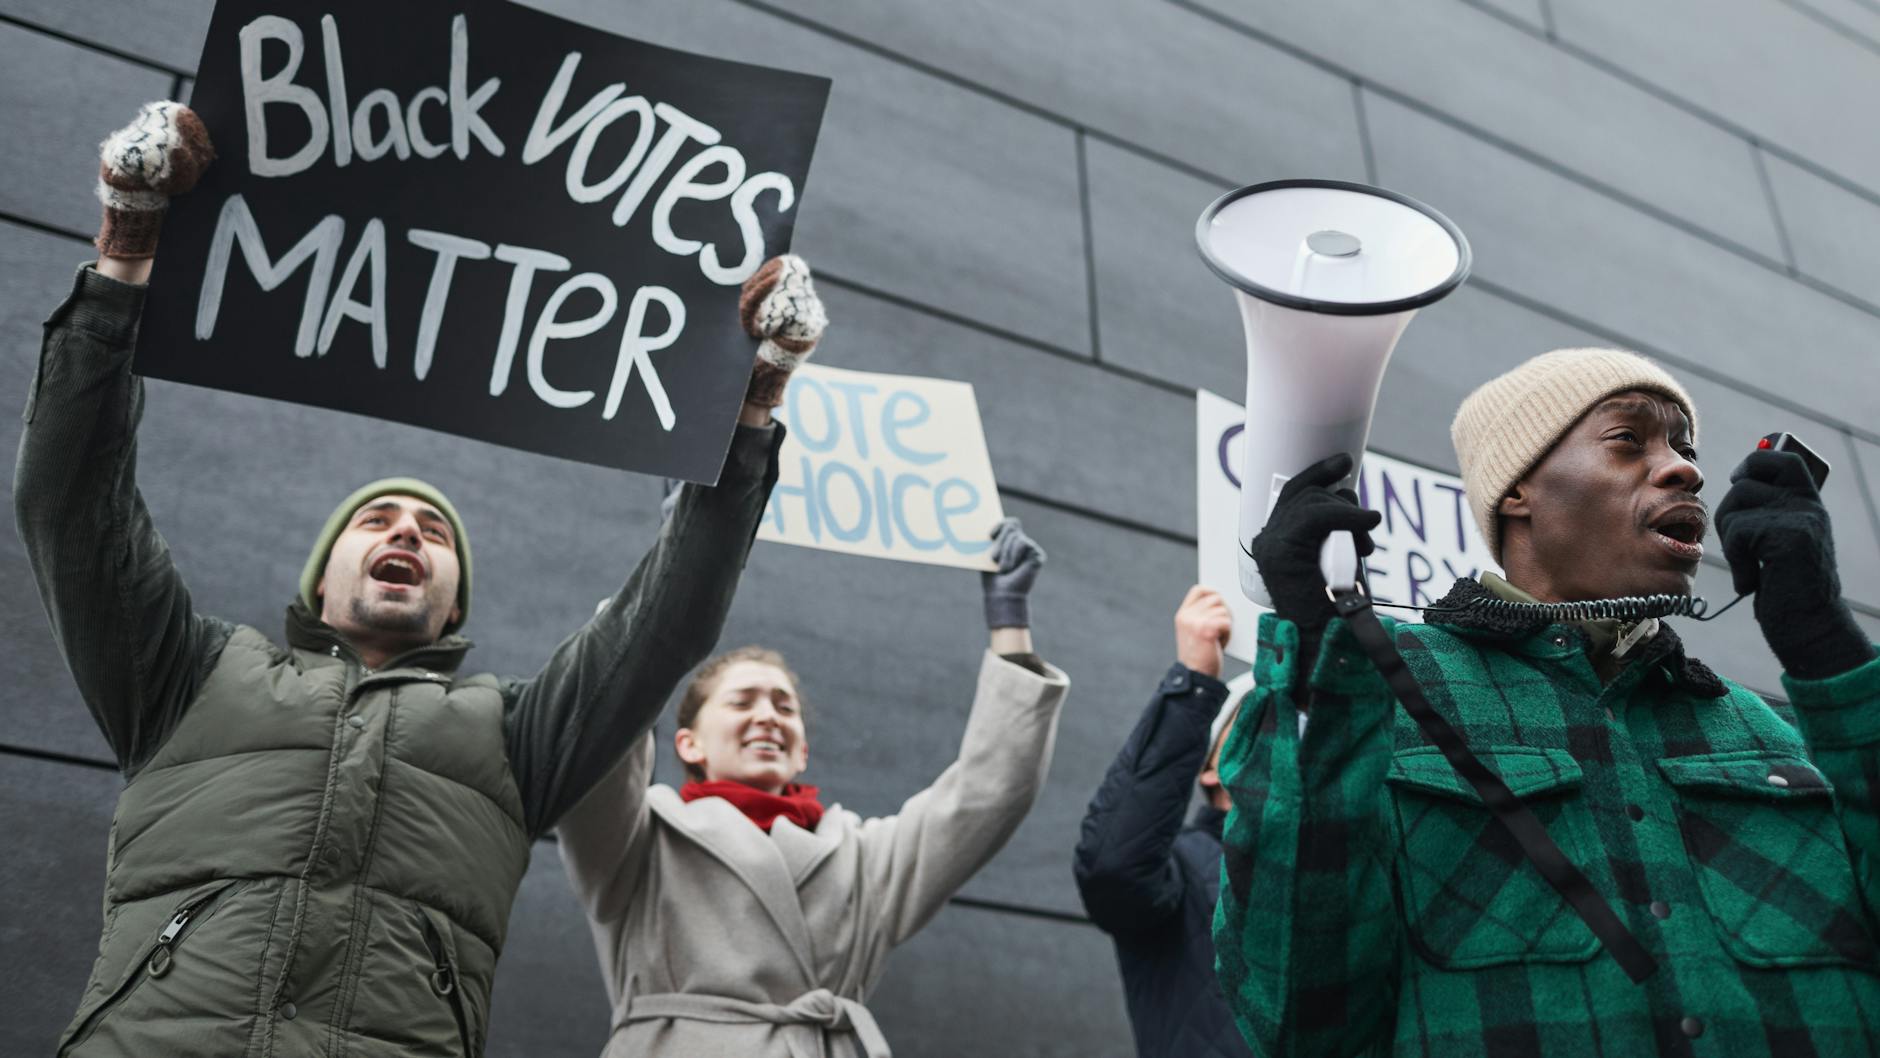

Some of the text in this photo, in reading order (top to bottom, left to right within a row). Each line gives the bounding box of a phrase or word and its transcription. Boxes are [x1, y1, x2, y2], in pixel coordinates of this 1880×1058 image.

[240, 14, 505, 178] Black
[787, 375, 948, 465] OTe
[762, 456, 993, 554] HOICe
